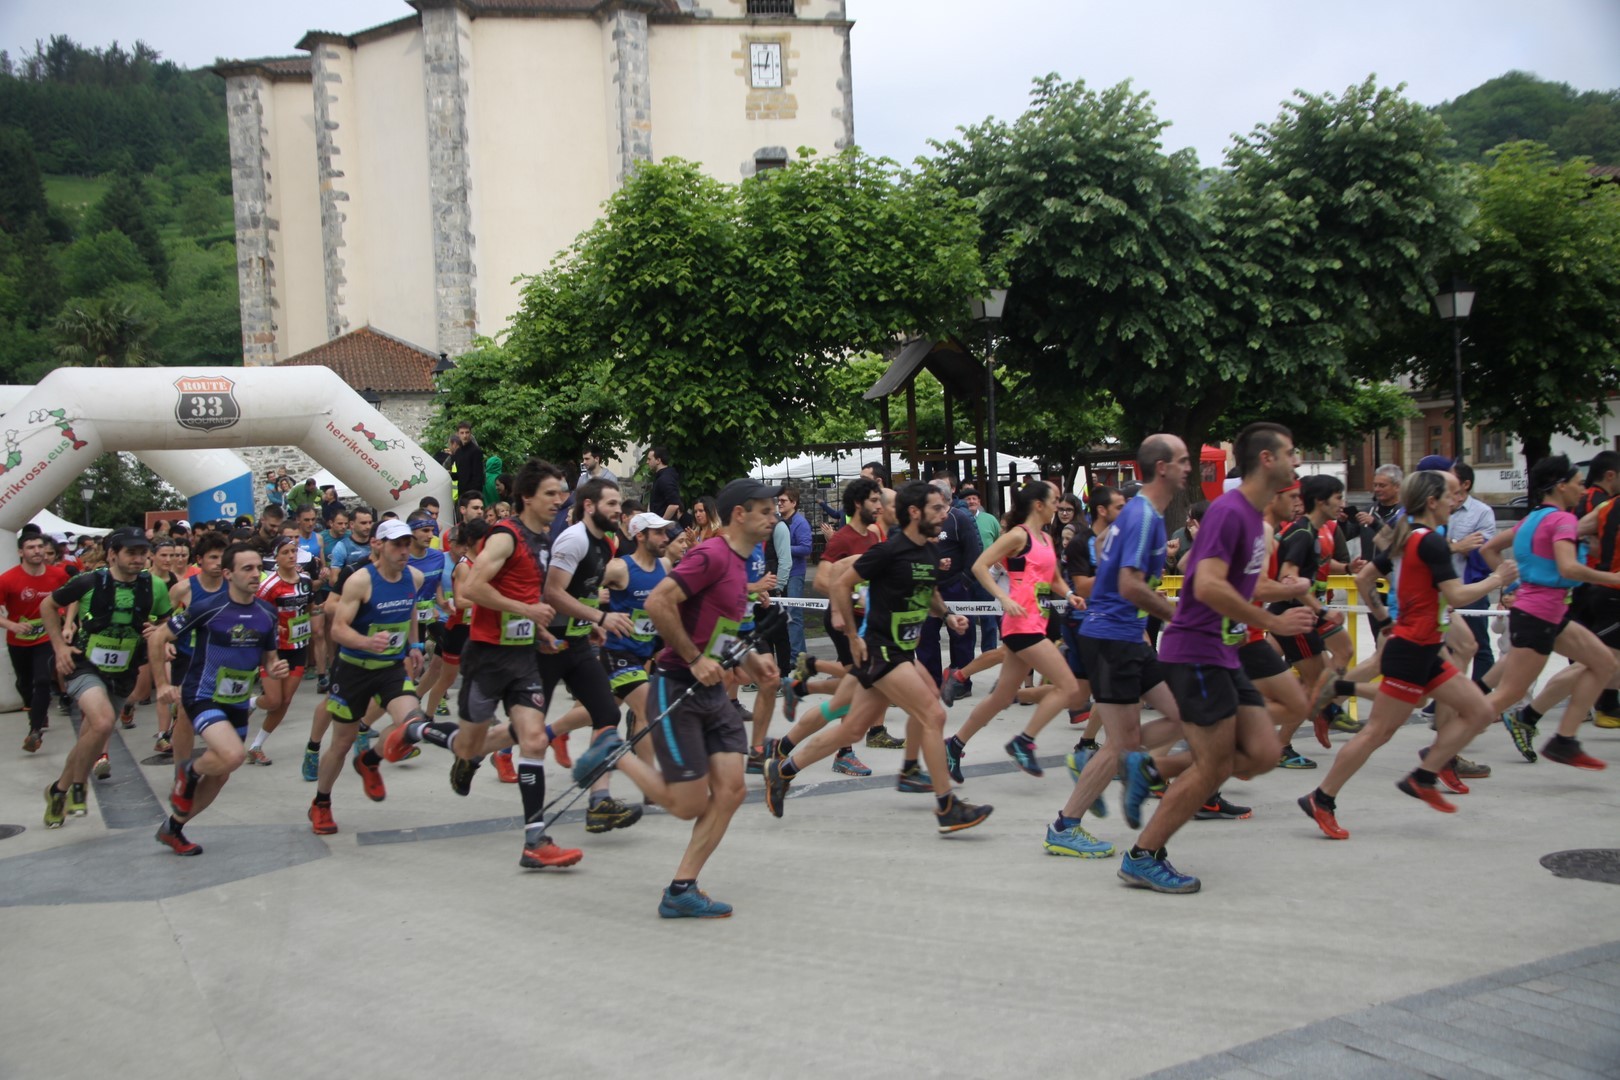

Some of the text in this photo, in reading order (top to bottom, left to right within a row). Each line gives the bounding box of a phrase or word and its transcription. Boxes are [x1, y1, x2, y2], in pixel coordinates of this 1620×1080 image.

[182, 381, 228, 391] ROUTE
[191, 396, 223, 417] 33
[326, 421, 400, 487] herrikrosa.eus
[104, 652, 119, 664] 13
